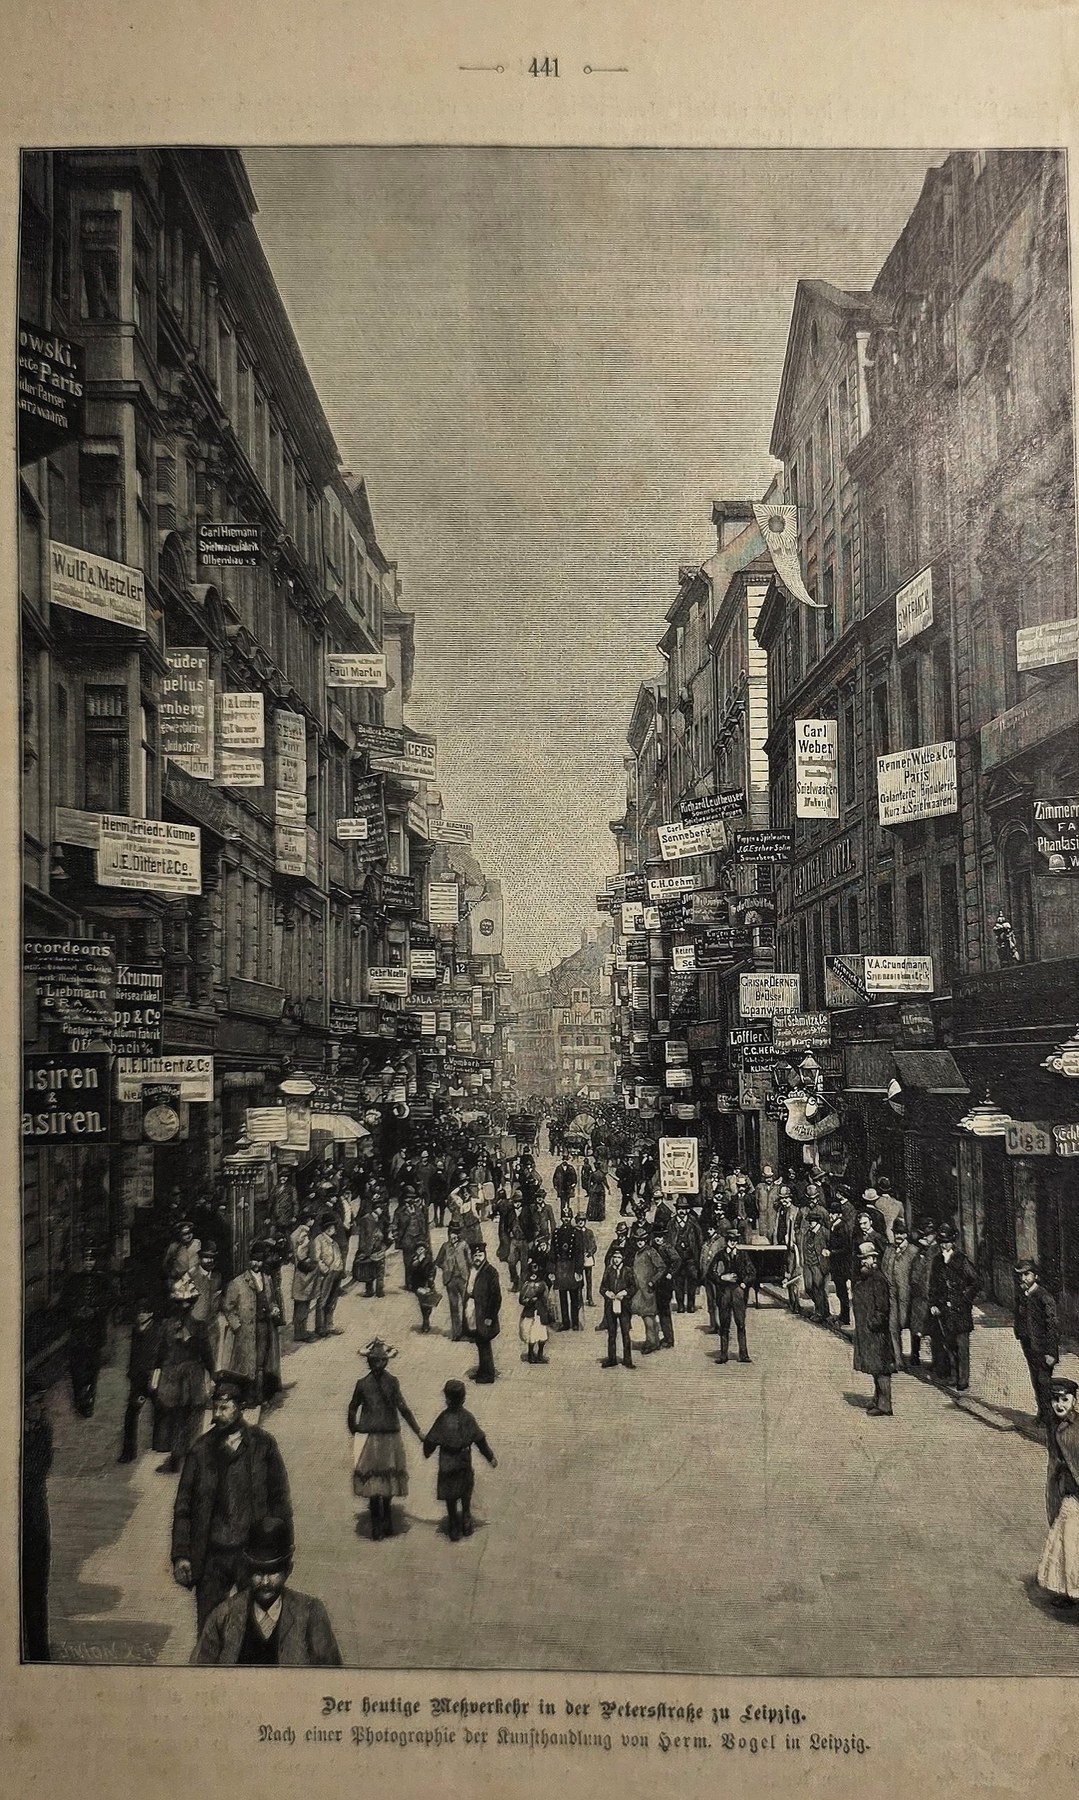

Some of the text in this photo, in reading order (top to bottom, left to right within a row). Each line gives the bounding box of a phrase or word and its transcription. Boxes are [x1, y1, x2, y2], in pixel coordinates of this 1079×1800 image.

[528, 57, 561, 78] 441
[40, 362, 83, 397] Paris
[53, 552, 88, 583] Wulf
[97, 566, 143, 601] Metzler
[330, 666, 382, 677] Paul Martin
[804, 724, 826, 738] Carl
[798, 740, 834, 753] Weber
[879, 757, 911, 773] Renner
[905, 769, 930, 784] Paris
[116, 966, 162, 988] Krumm
[46, 984, 107, 999] Liebmann
[134, 1010, 142, 1024] &
[730, 1030, 763, 1045] Löffler
[48, 1091, 58, 1103] &
[322, 1696, 352, 1716] Der
[361, 1696, 421, 1717] heutige
[539, 1699, 556, 1715] in
[566, 1700, 590, 1716] der
[711, 1708, 730, 1724] zu
[739, 1703, 807, 1724] Leipzig.
[259, 1724, 296, 1745] Nach
[305, 1726, 343, 1742] einer
[351, 1725, 456, 1748] Photographie
[463, 1726, 489, 1743] der
[621, 1733, 649, 1747] von
[658, 1732, 712, 1752] Herm.
[721, 1732, 776, 1753] Vogel
[785, 1733, 801, 1749] in
[809, 1733, 871, 1754] Leipzig.
